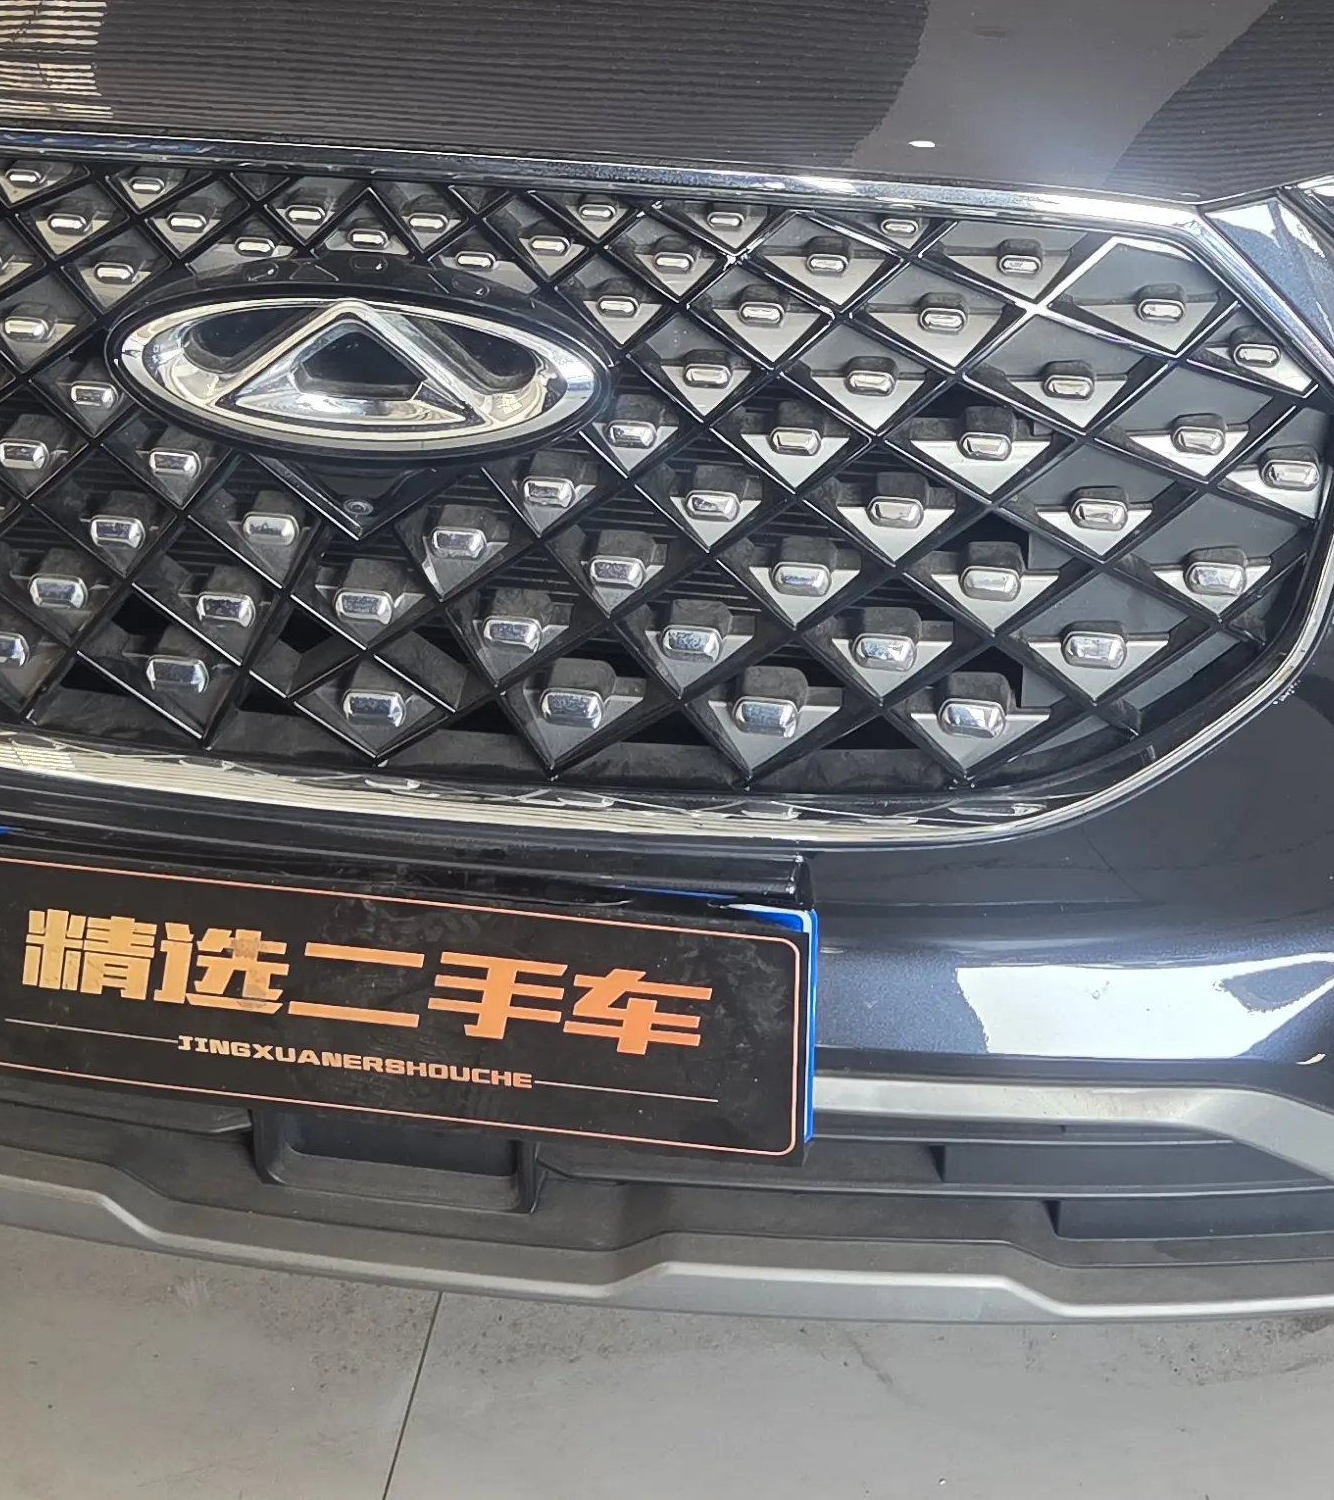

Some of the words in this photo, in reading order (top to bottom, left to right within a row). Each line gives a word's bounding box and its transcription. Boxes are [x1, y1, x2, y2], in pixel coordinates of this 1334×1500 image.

[23, 908, 713, 1055] 精选二手车
[178, 1032, 534, 1090] JINGXUANERSHOUCHE
